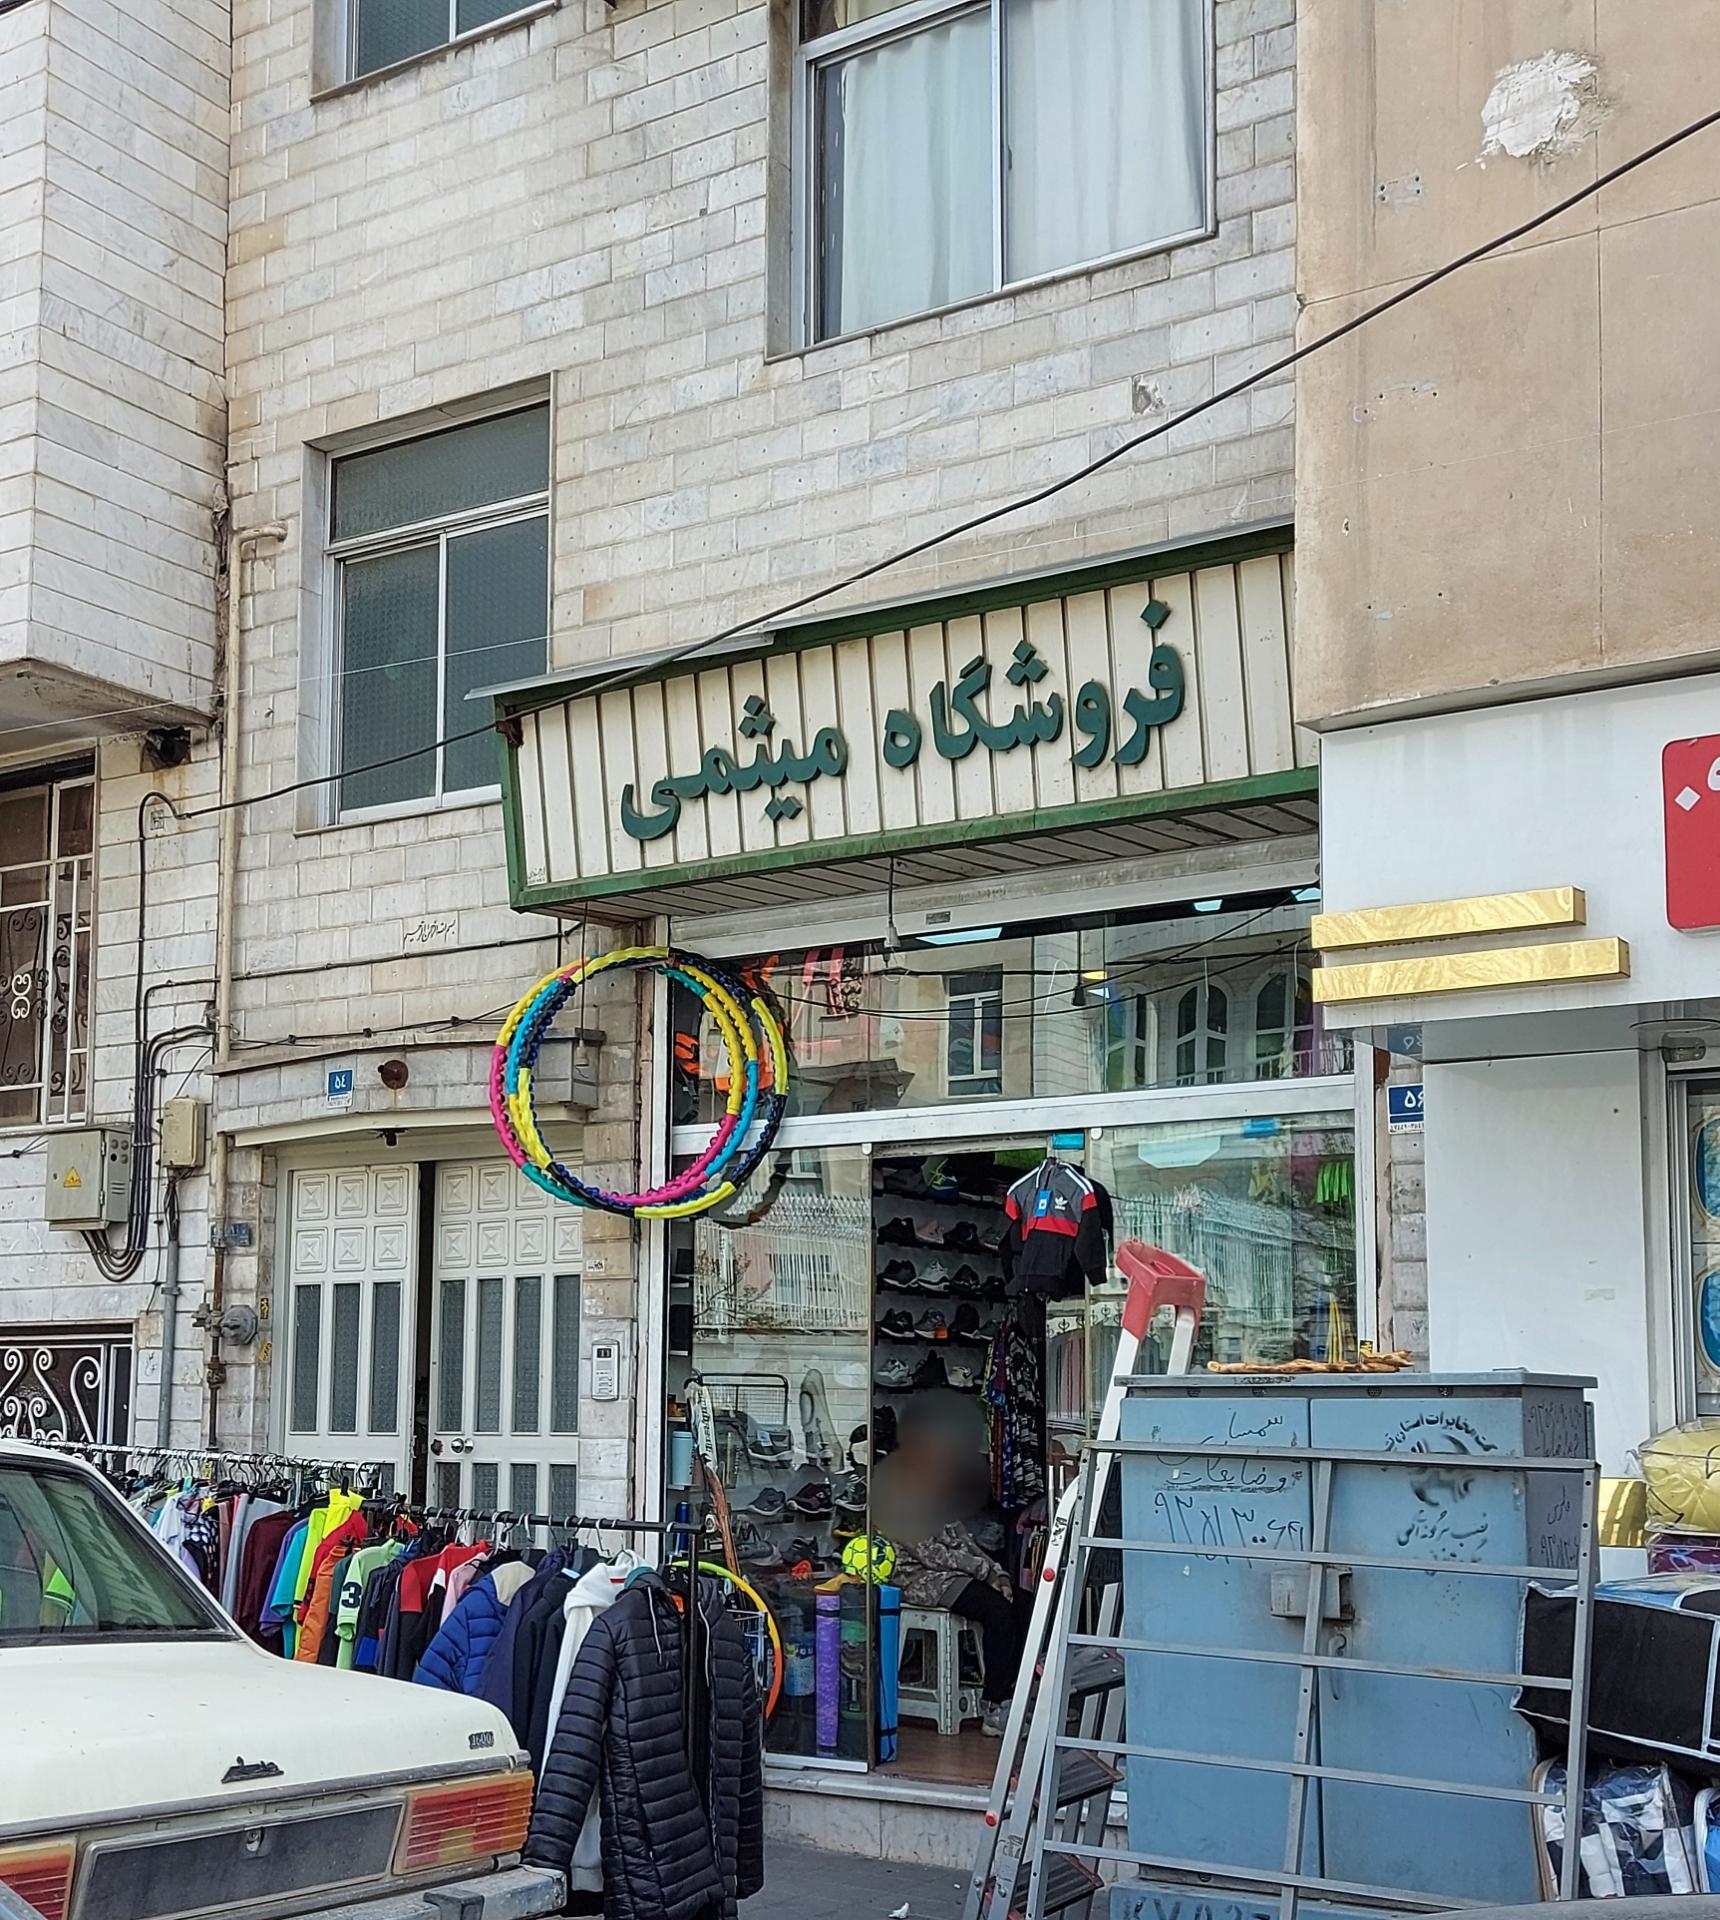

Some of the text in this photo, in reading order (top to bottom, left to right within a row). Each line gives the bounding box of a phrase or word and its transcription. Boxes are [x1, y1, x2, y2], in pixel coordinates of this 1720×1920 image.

[620, 601, 1185, 842] فروشگاه میثمی
[342, 1582, 362, 1609] 3
